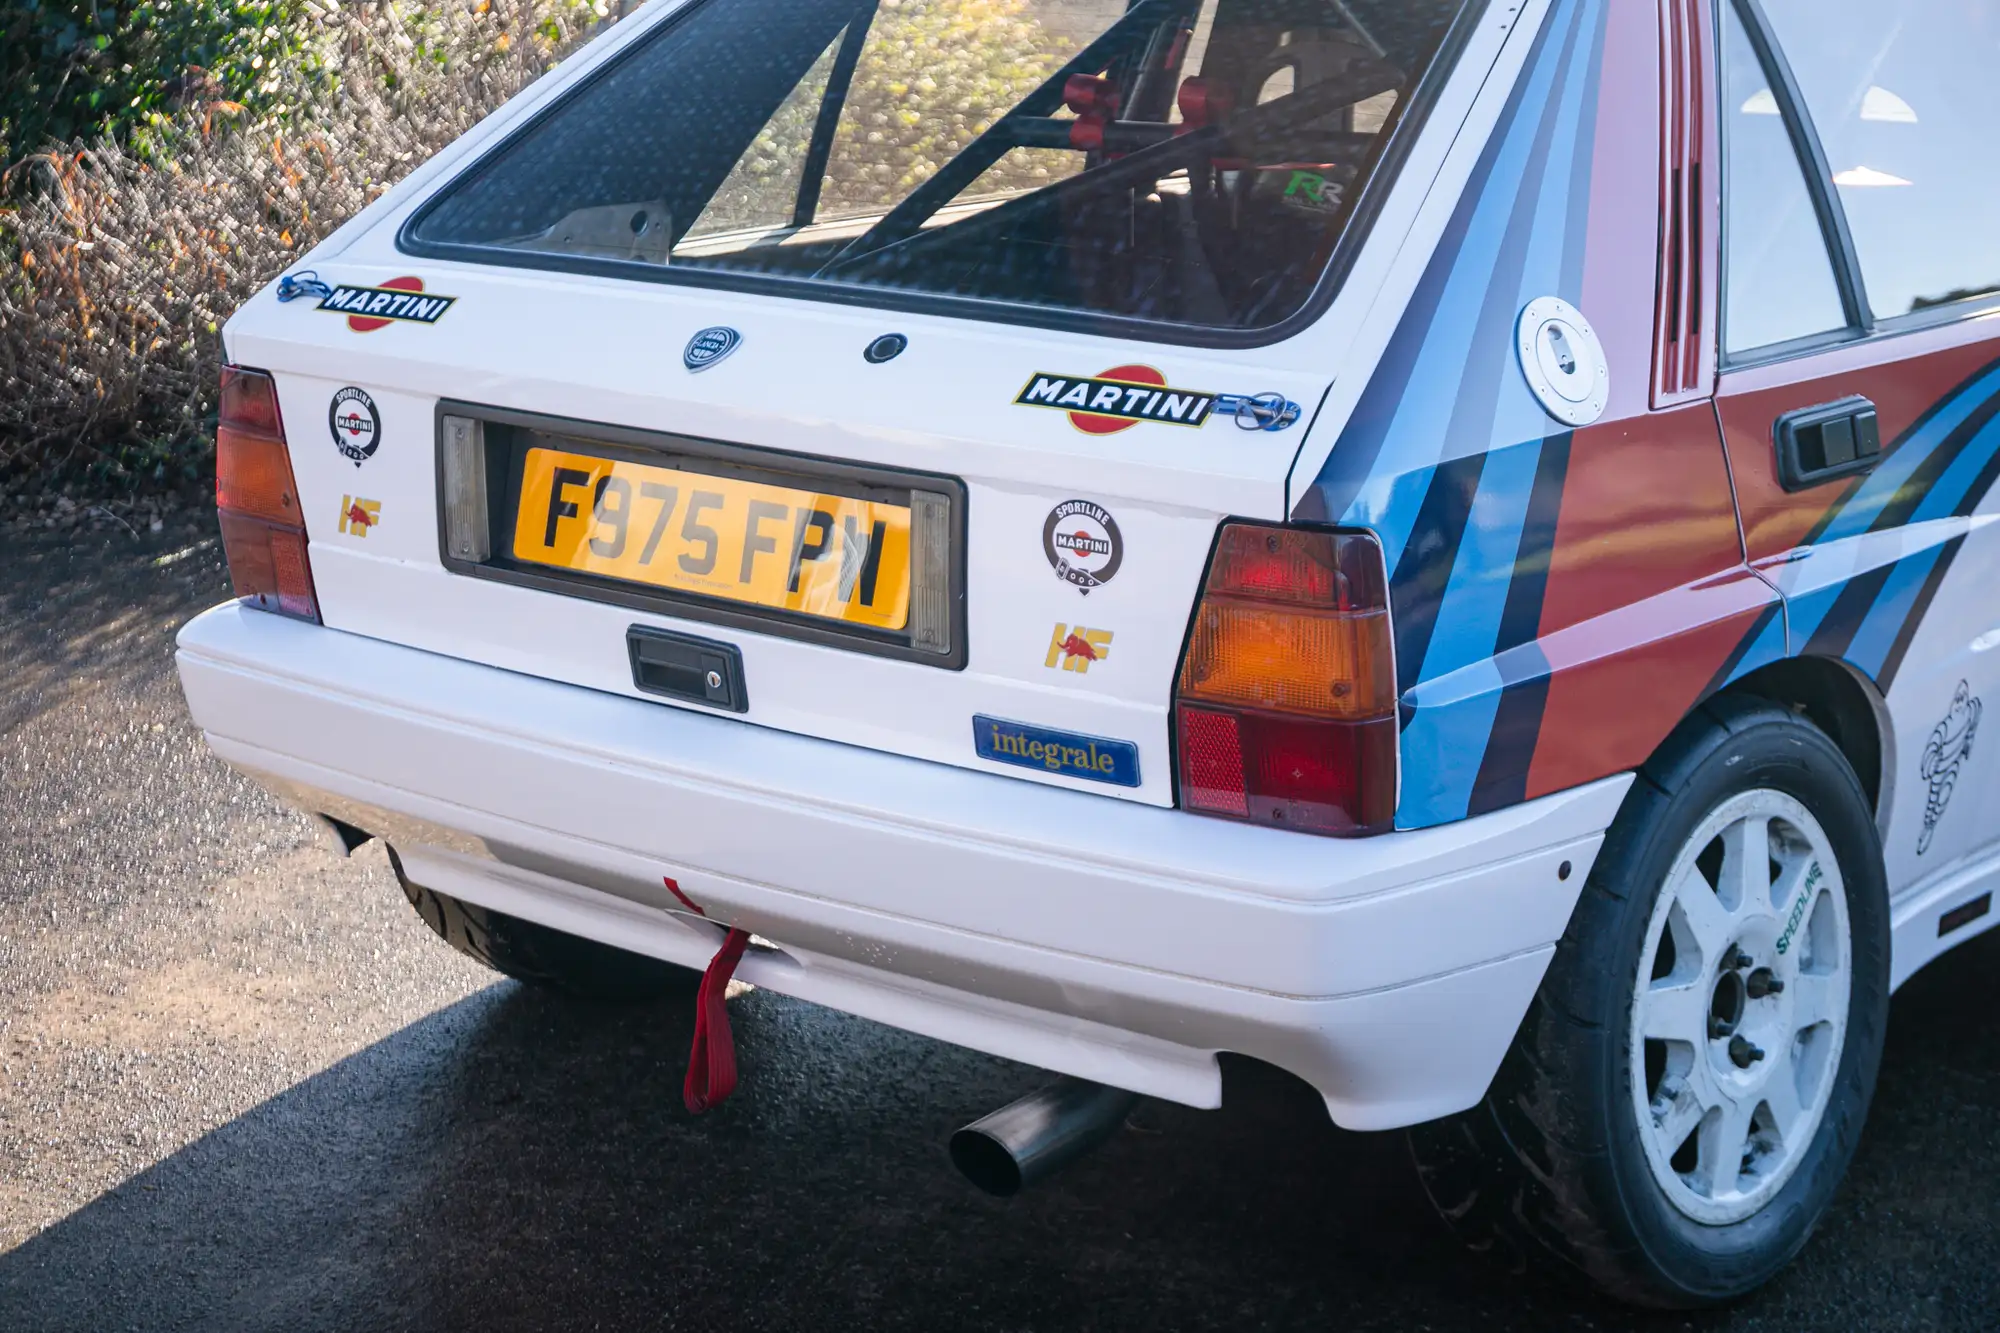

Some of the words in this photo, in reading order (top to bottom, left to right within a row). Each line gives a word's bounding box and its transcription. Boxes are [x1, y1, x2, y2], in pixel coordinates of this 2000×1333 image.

[323, 288, 448, 320] MARTINI
[336, 388, 372, 408] SPORTLINE
[1026, 377, 1210, 421] MARTINI
[338, 417, 372, 432] MARTINI
[338, 494, 382, 538] HF
[543, 466, 725, 576] F975
[1056, 501, 1111, 526] SPORTLINE
[1057, 535, 1109, 553] MARTINI
[1044, 622, 1114, 674] HF
[991, 723, 1116, 774] integrale
[1776, 860, 1824, 955] SPEEDLINE
